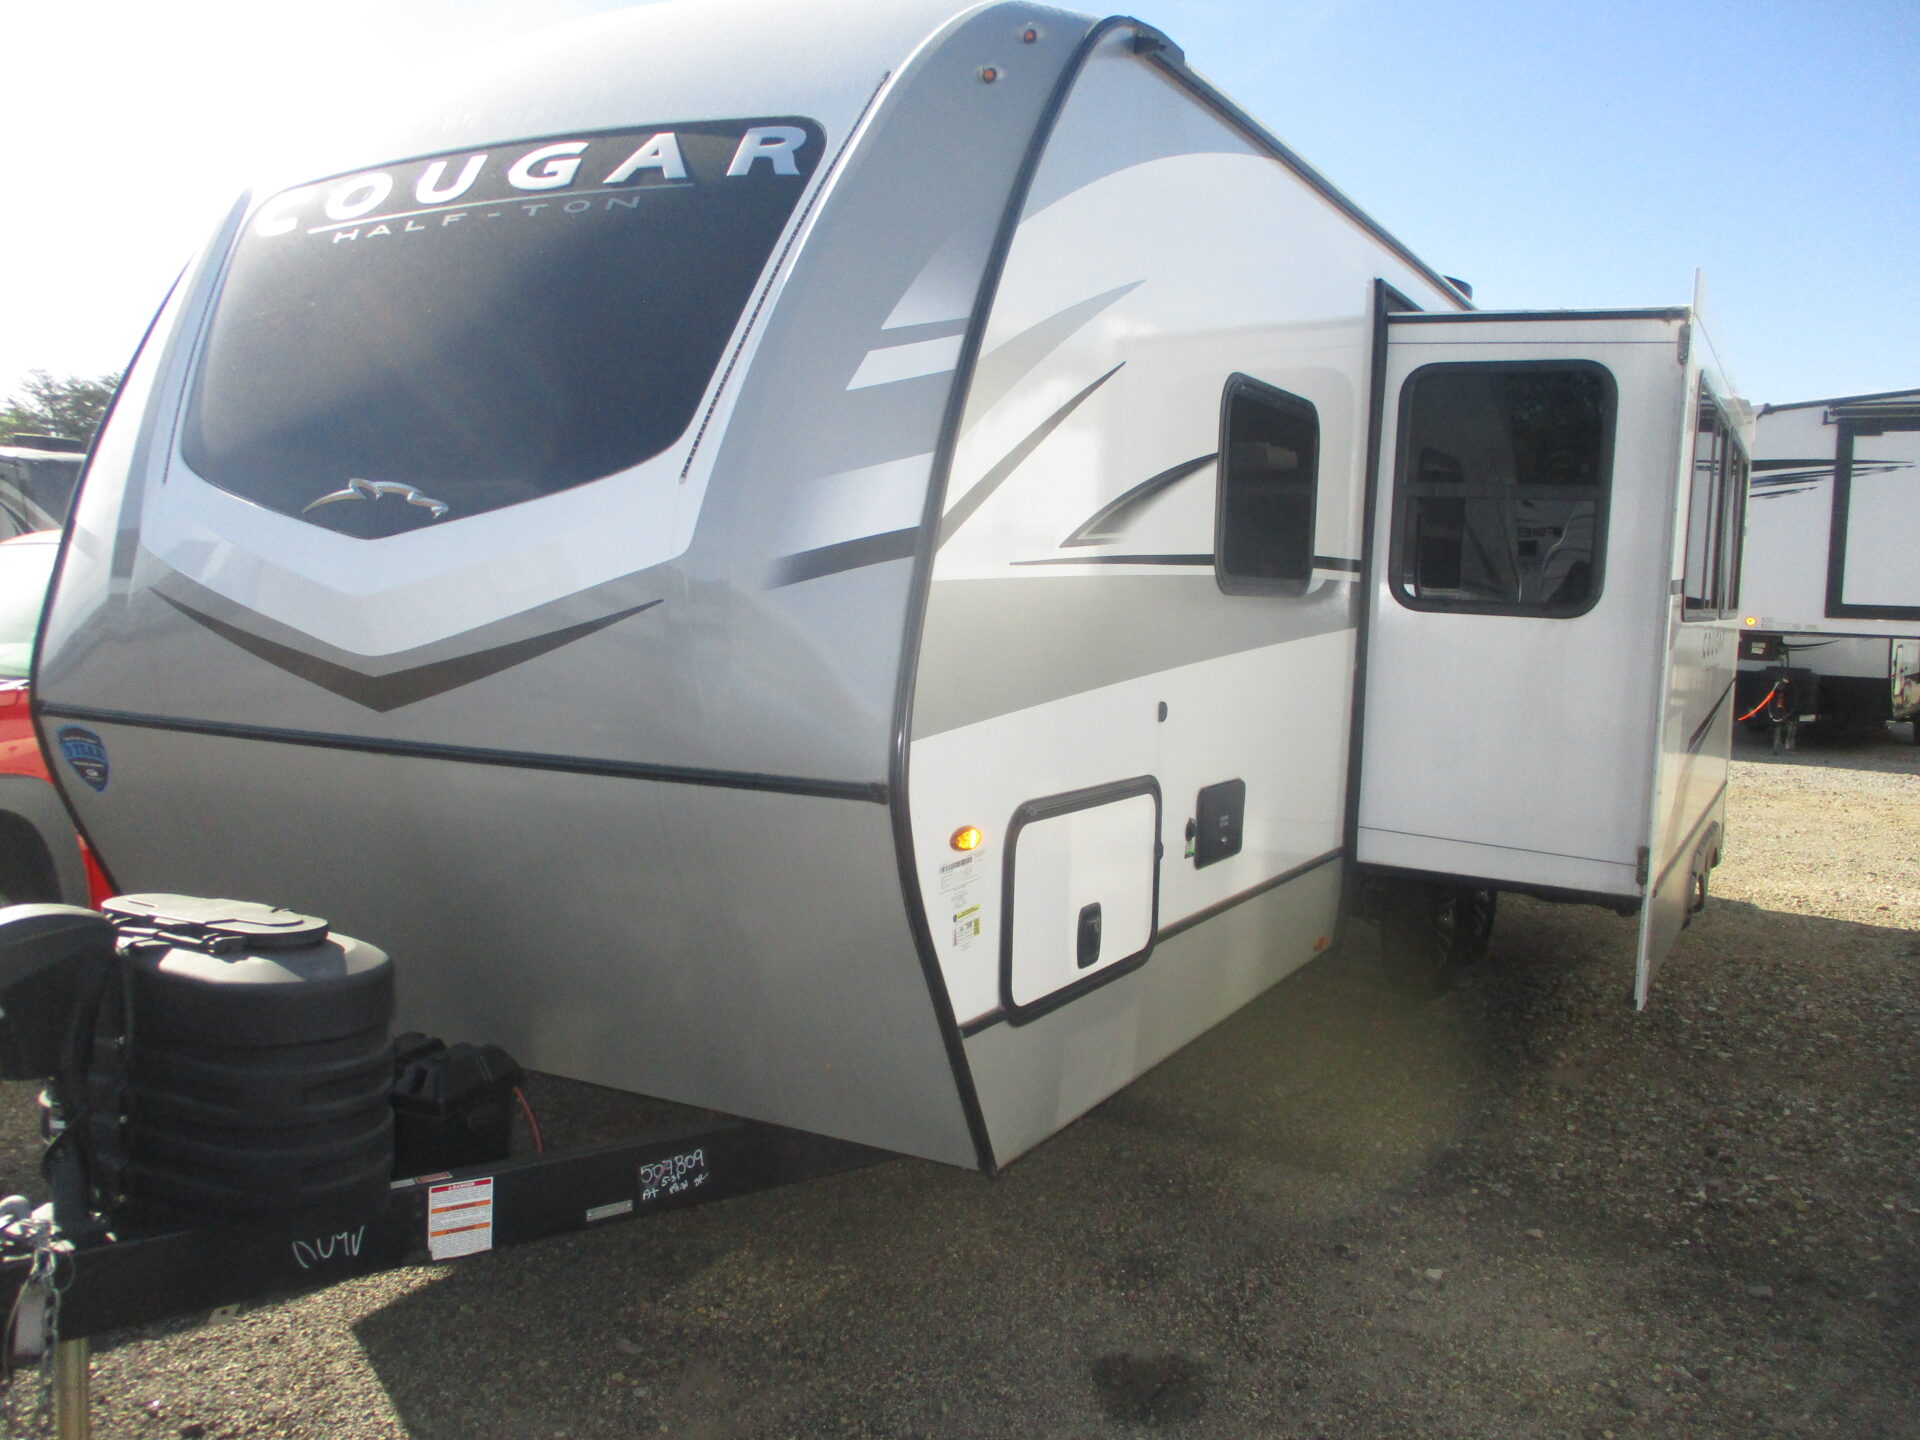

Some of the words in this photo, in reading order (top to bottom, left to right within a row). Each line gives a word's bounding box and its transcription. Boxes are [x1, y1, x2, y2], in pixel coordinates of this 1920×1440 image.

[254, 126, 807, 237] COUGAR
[333, 196, 641, 244] HALF-TON
[640, 1149, 704, 1183] 507809
